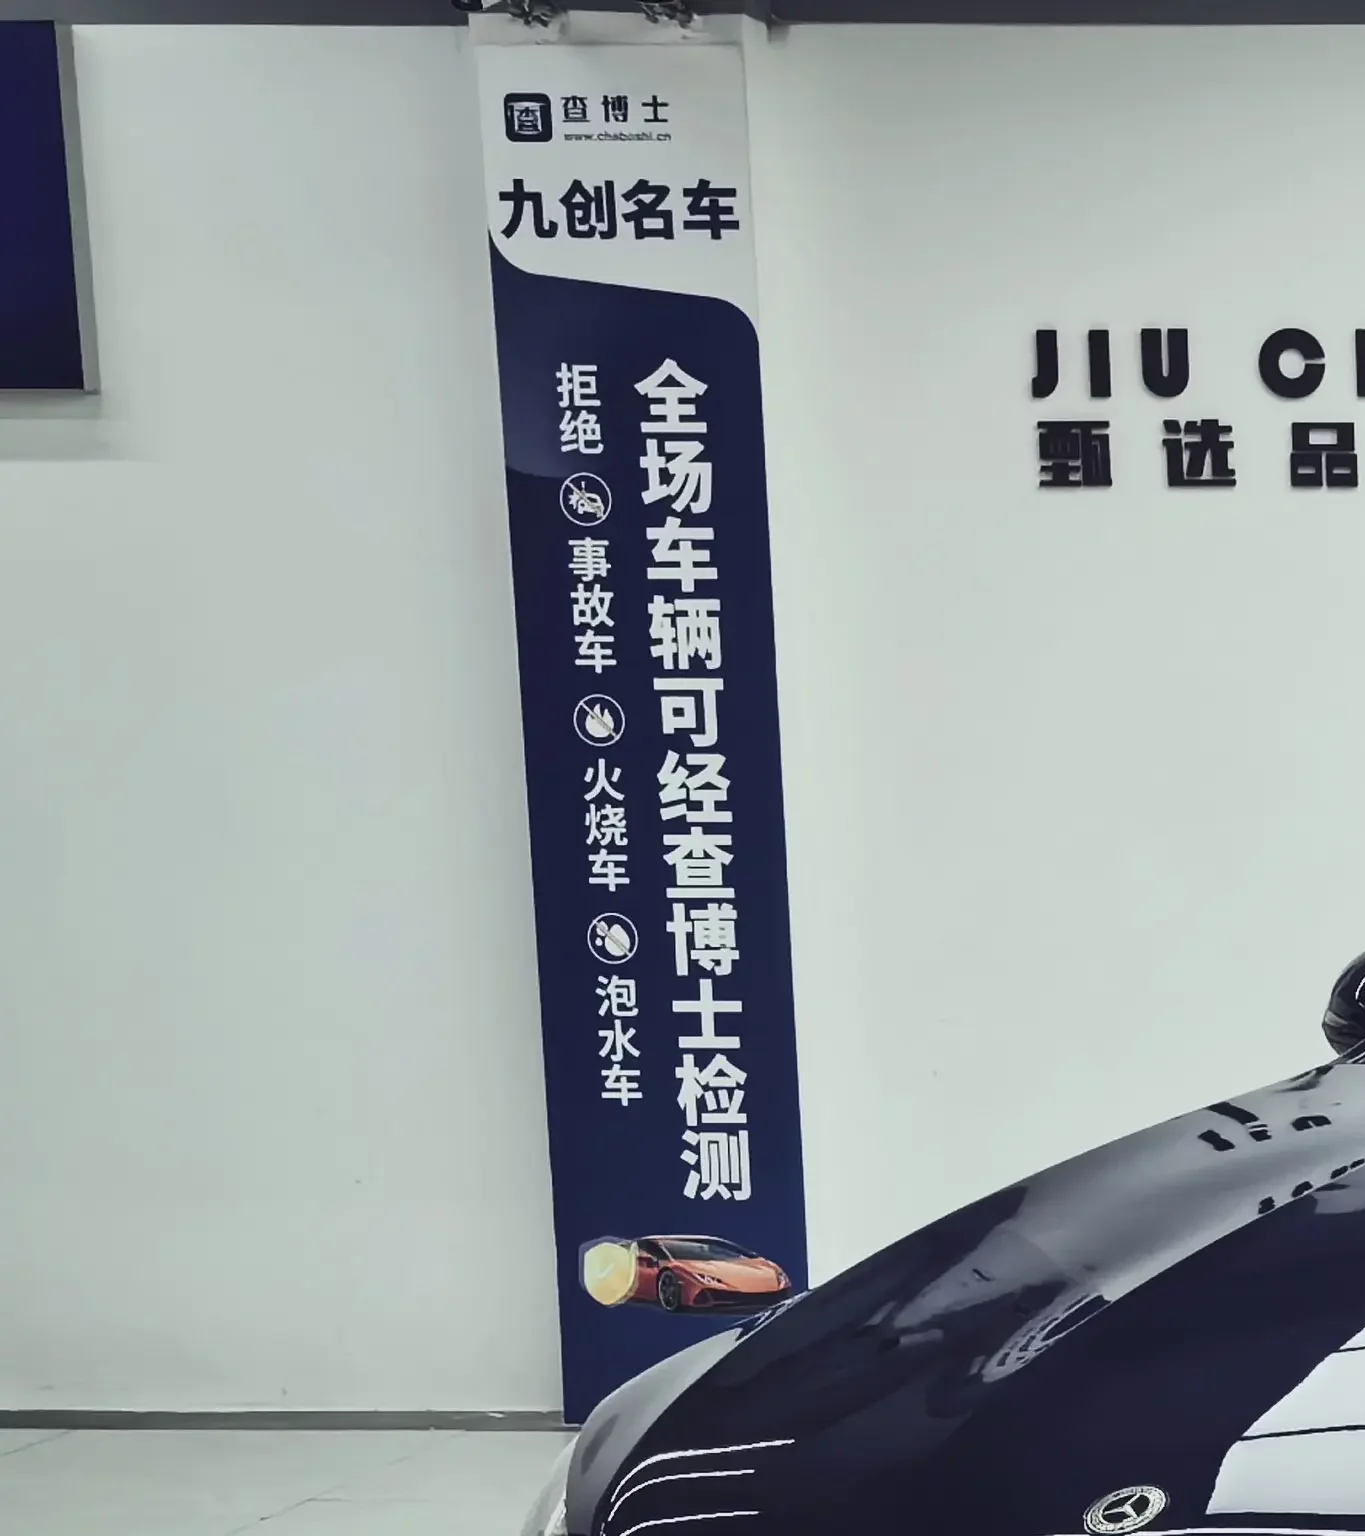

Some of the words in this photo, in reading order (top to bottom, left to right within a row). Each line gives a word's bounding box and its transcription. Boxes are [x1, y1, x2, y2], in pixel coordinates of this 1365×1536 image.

[561, 95, 669, 122] 查博士
[498, 178, 740, 239] 九创名车
[556, 362, 604, 455] 拒绝
[1031, 327, 1189, 398] JIU
[568, 537, 617, 673] 事故车
[583, 758, 629, 891] 火烧车
[633, 358, 752, 1201] 全场车辆可经查博士检测
[594, 975, 643, 1106] 泡水车
